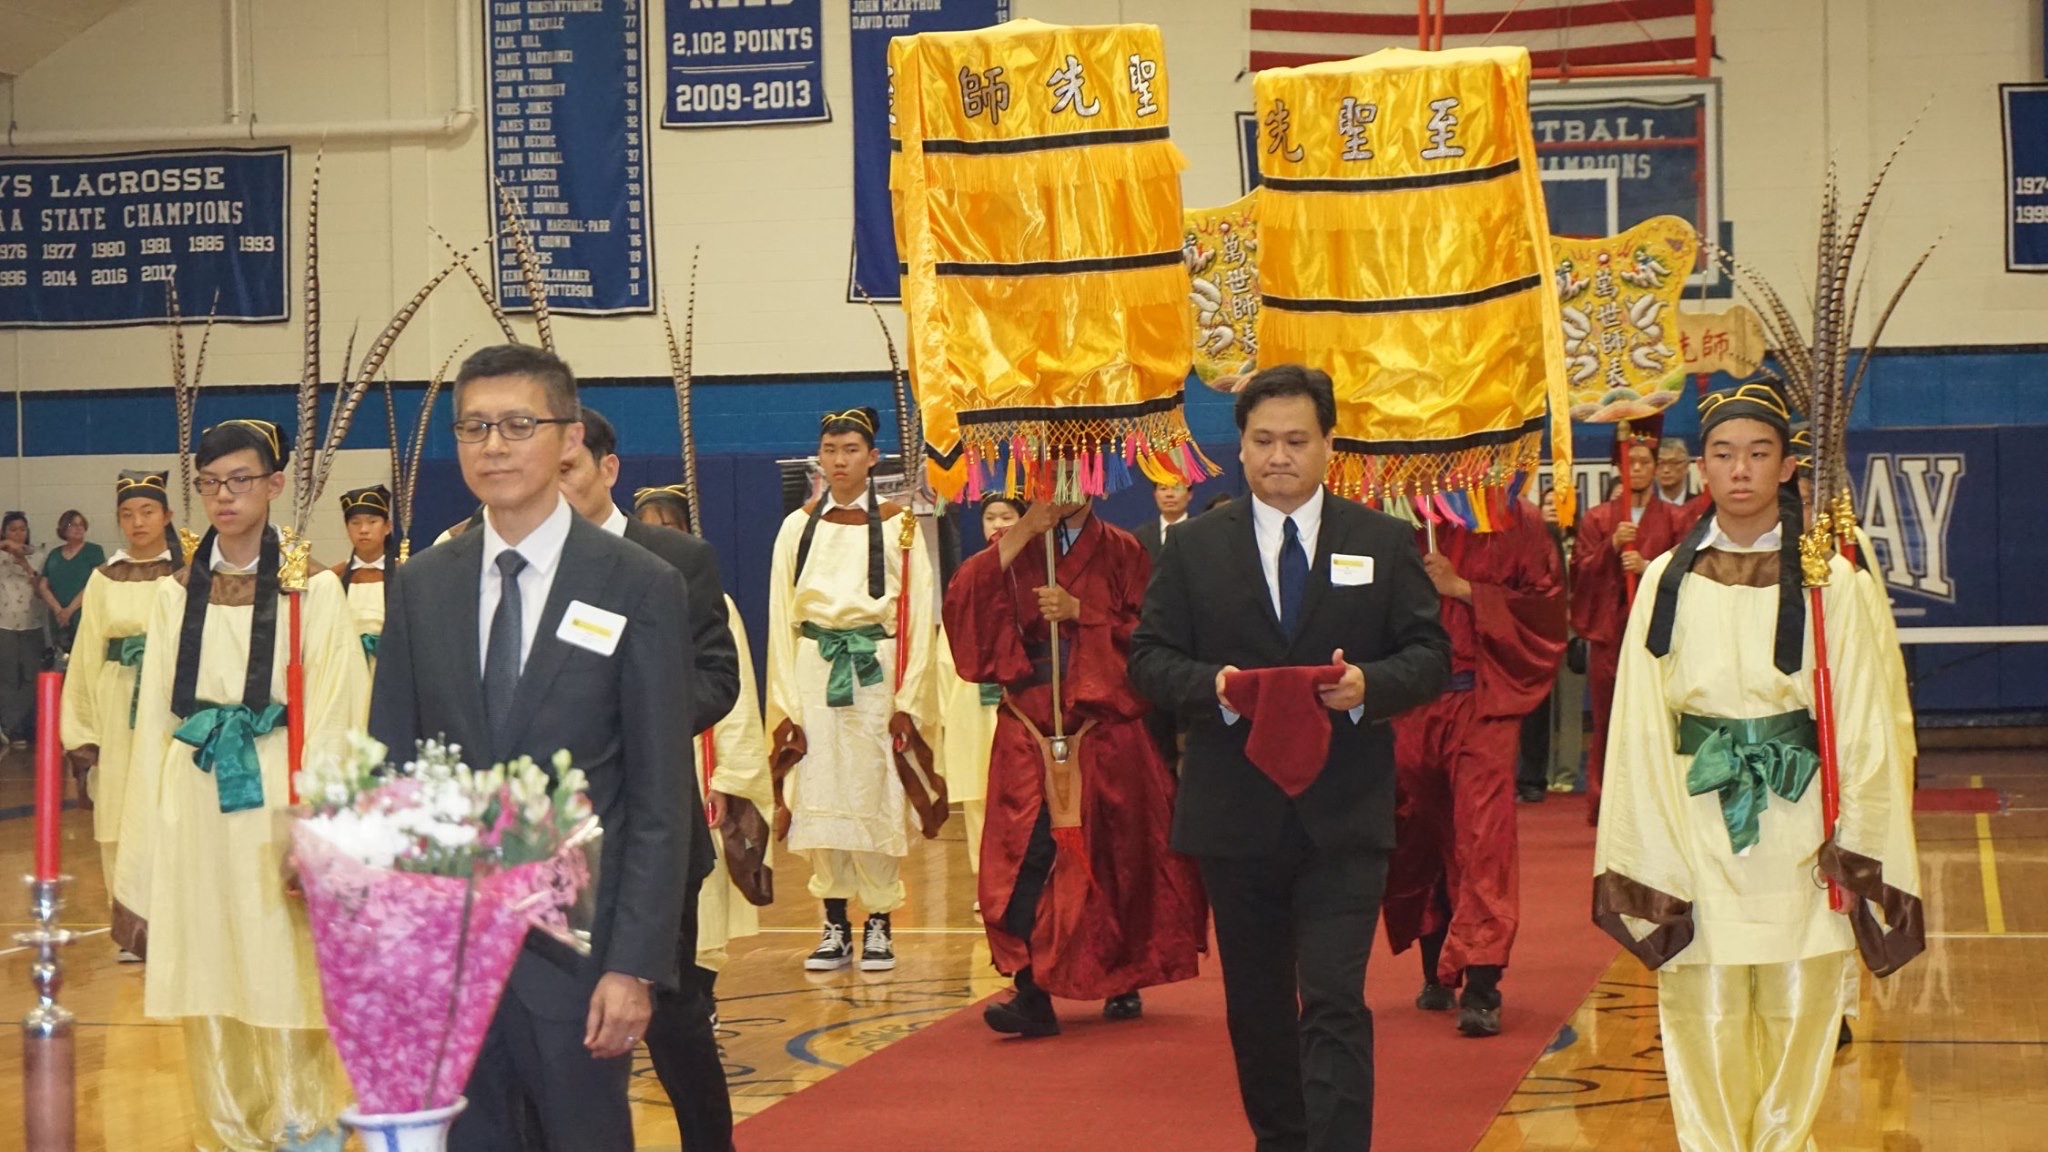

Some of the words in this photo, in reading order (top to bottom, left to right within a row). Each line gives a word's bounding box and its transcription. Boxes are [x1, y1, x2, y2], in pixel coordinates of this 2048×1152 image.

[852, 15, 883, 29] DAVID
[673, 32, 726, 57] 2,102
[734, 27, 813, 53] POINTS
[676, 80, 811, 112] 2009-2013
[1535, 116, 1666, 143] TBALL
[50, 166, 225, 198] LACROSSE
[41, 207, 106, 232] STATE
[123, 200, 244, 229] CHAMPIONS
[42, 243, 78, 259] 1977
[189, 235, 225, 252] 1985
[239, 235, 275, 252] 1993
[42, 269, 78, 287] 2014
[91, 268, 128, 286] 2016
[140, 264, 177, 283] 2017
[1595, 268, 1631, 389] 萬世師表
[1858, 453, 1966, 603] AY
